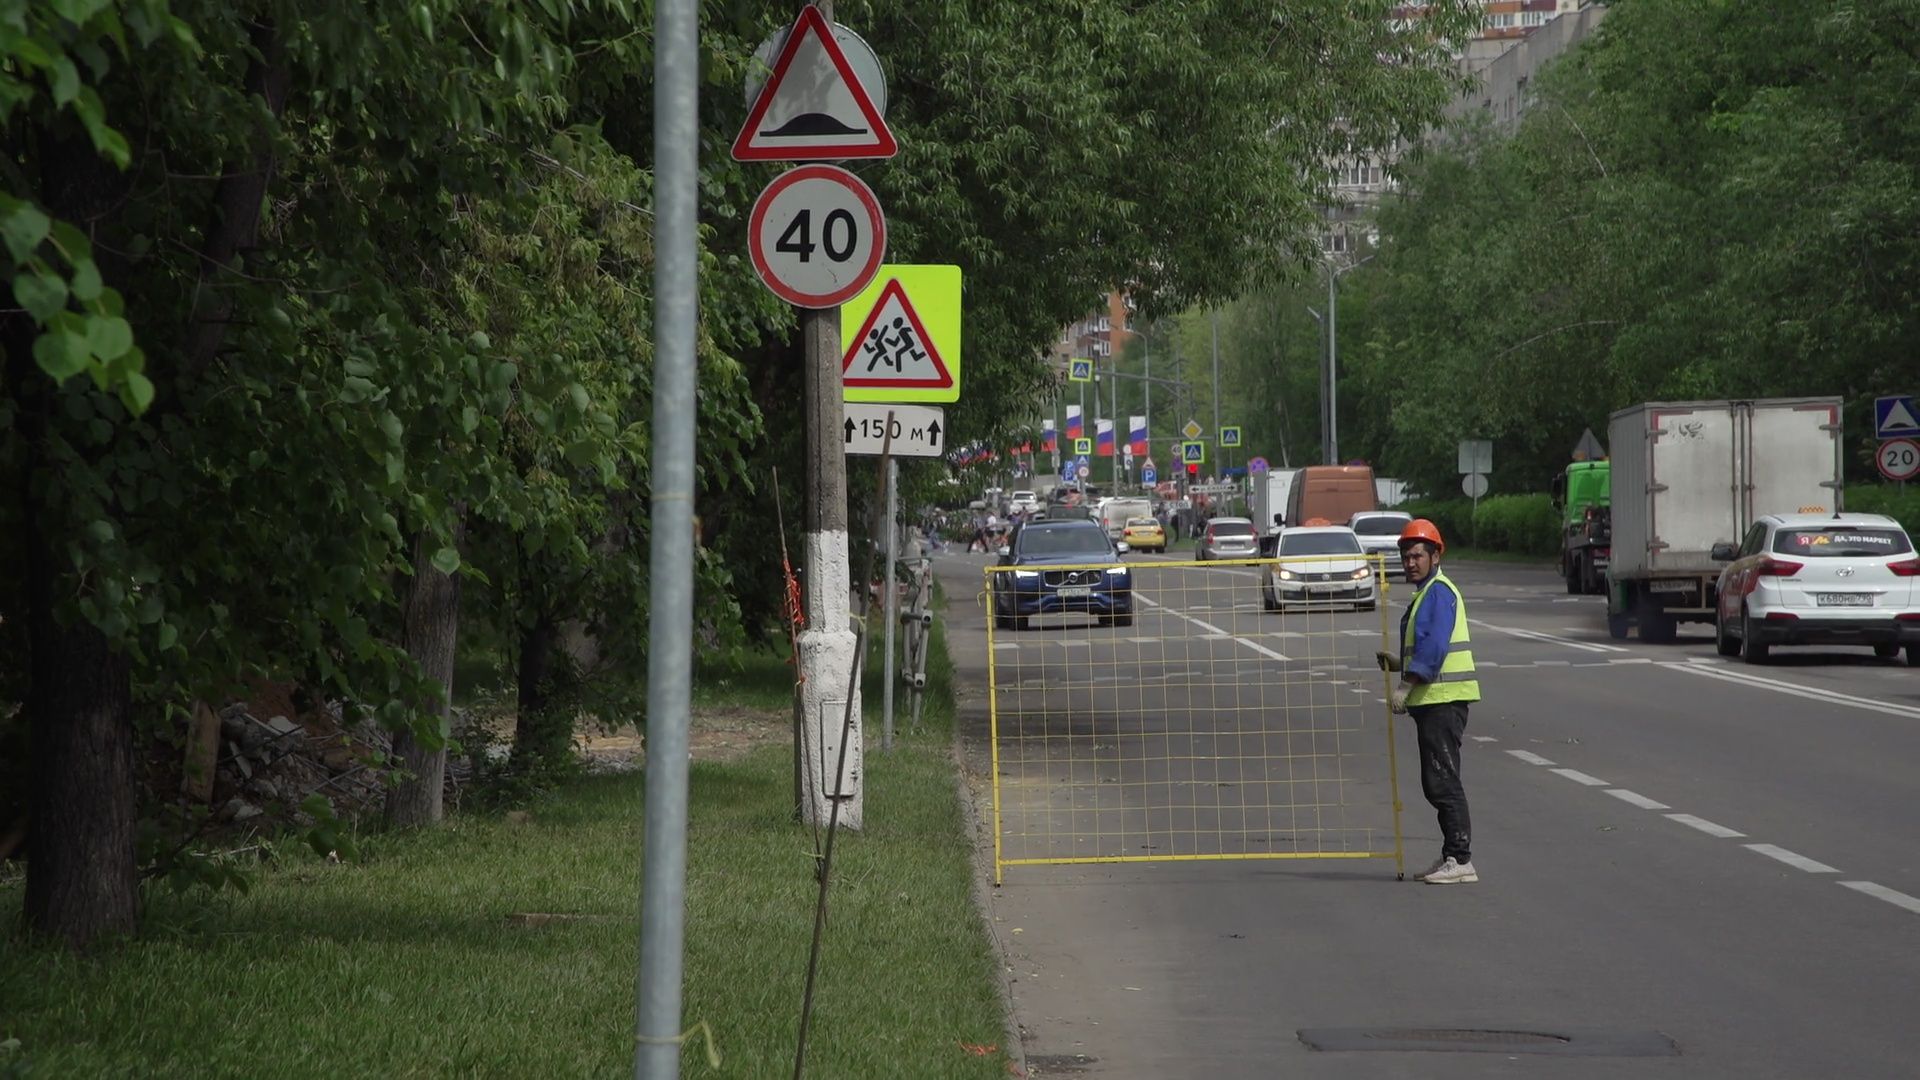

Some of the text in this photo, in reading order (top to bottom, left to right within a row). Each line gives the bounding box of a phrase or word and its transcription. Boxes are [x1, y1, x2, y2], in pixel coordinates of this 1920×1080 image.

[775, 208, 858, 263] 40
[860, 418, 902, 439] 150
[1886, 449, 1914, 467] 20
[1145, 469, 1153, 479] P
[1800, 536, 1809, 545] Я
[1834, 535, 1847, 543] ДА,
[1848, 535, 1861, 543] ЭТО
[1862, 536, 1892, 545] МАРКЕТ
